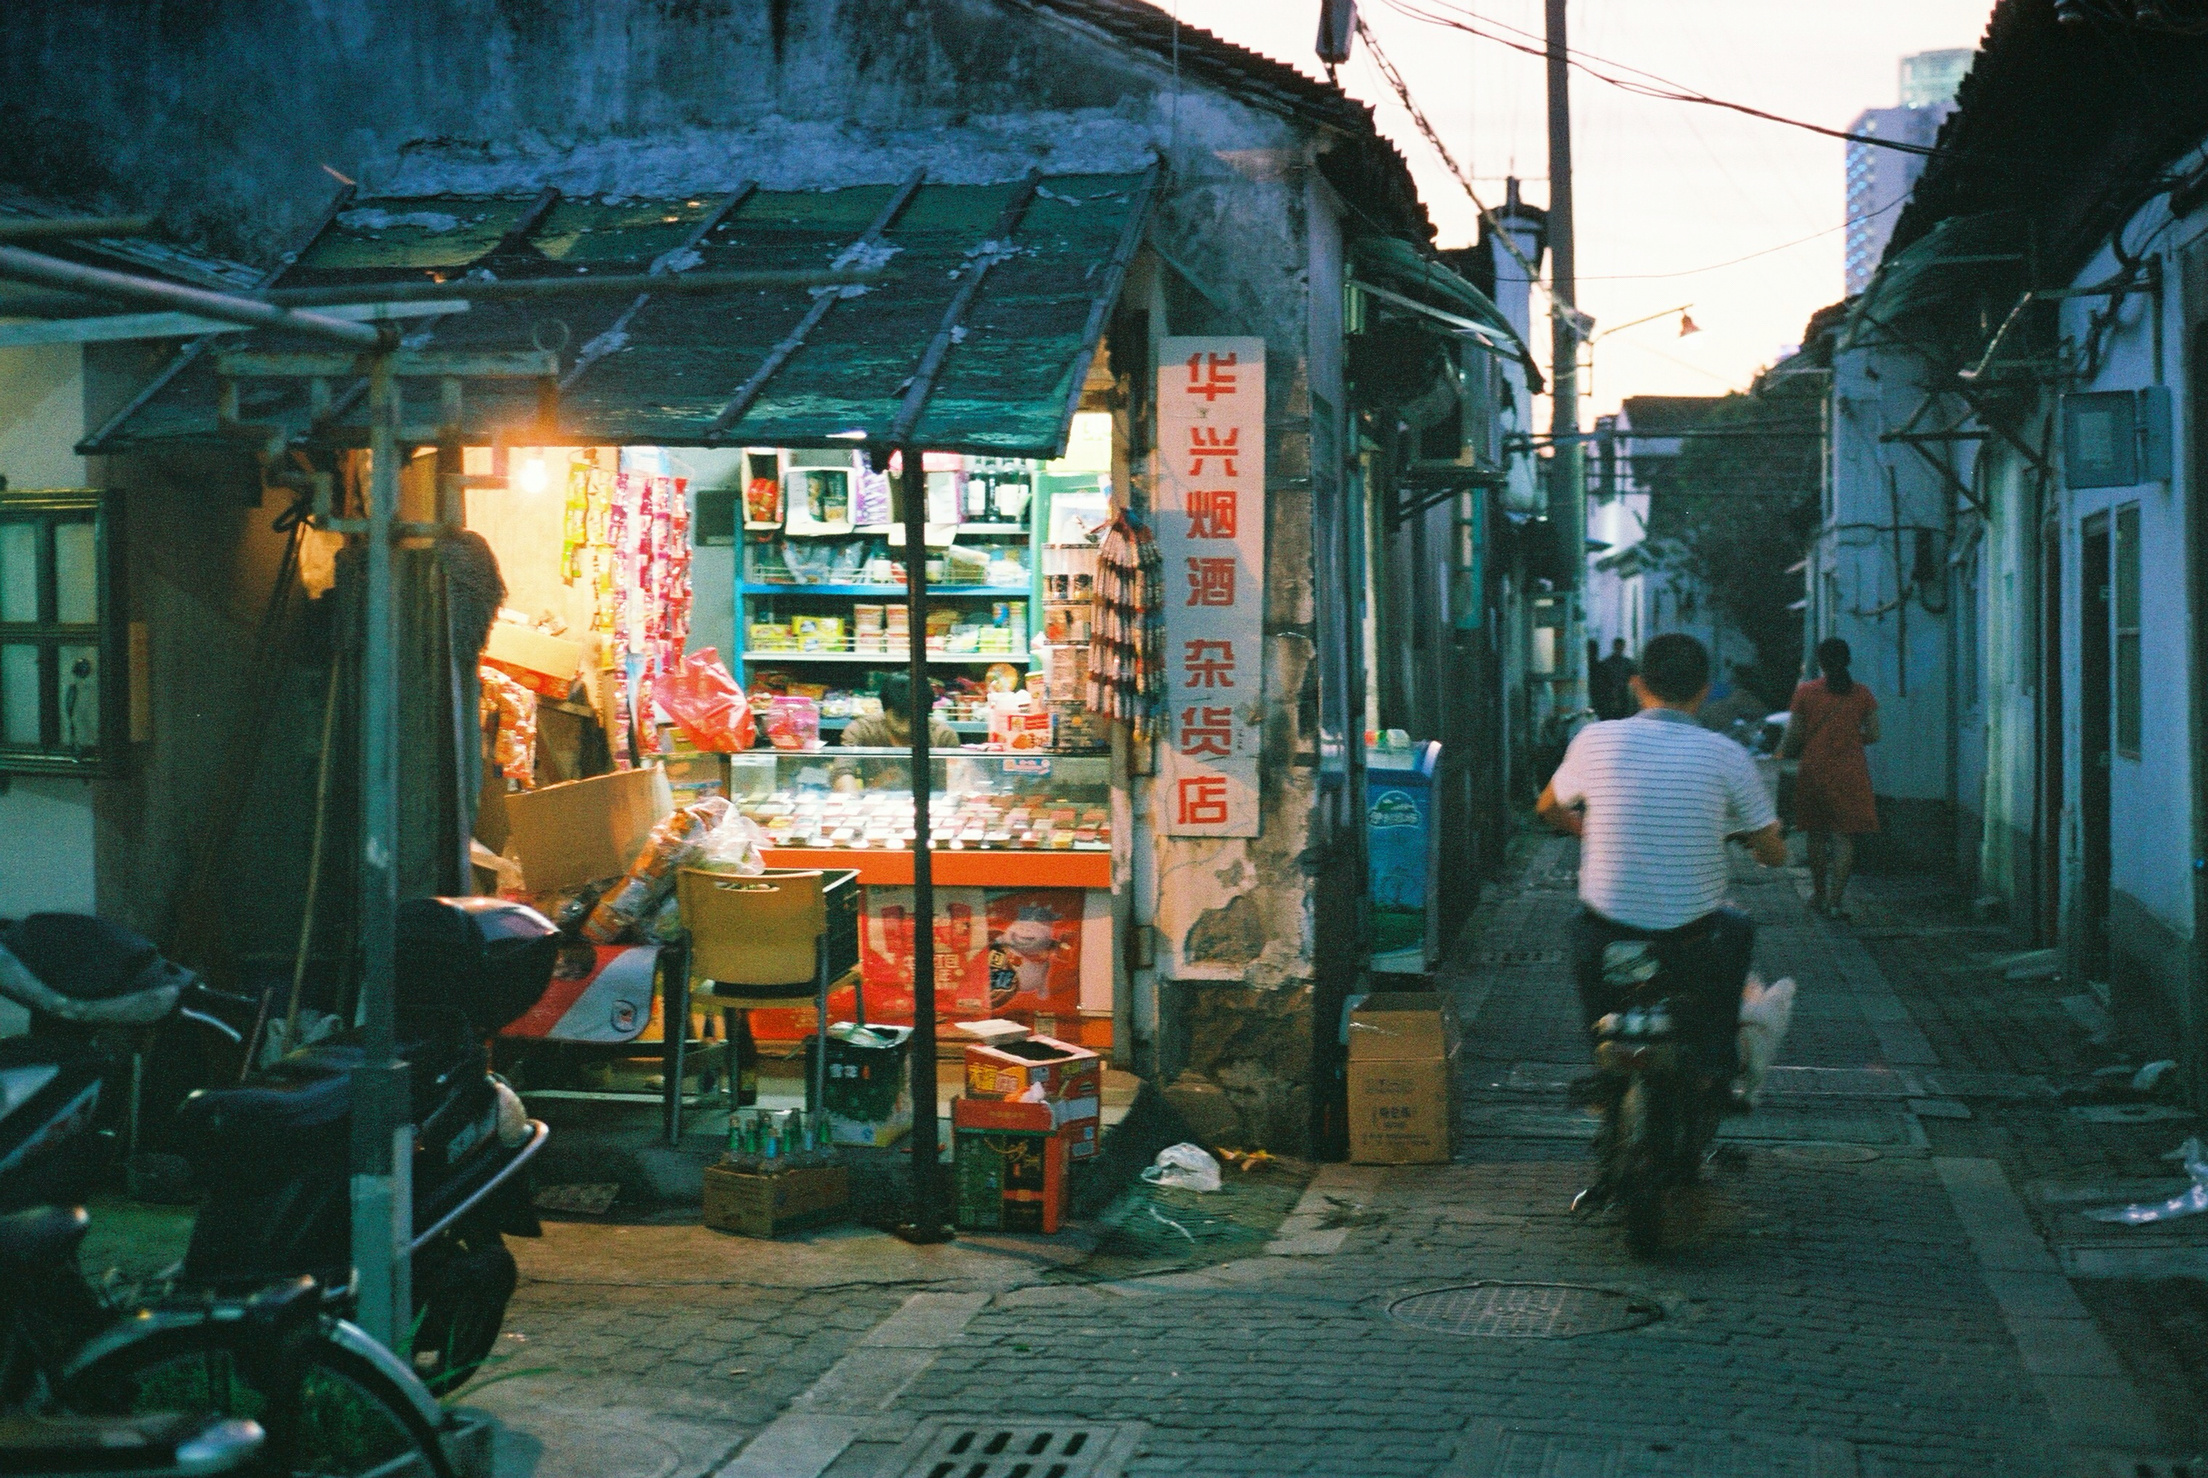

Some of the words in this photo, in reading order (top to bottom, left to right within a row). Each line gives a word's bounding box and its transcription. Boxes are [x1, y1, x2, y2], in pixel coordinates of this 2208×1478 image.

[1177, 352, 1239, 826] 华兴烟酒杂货店
